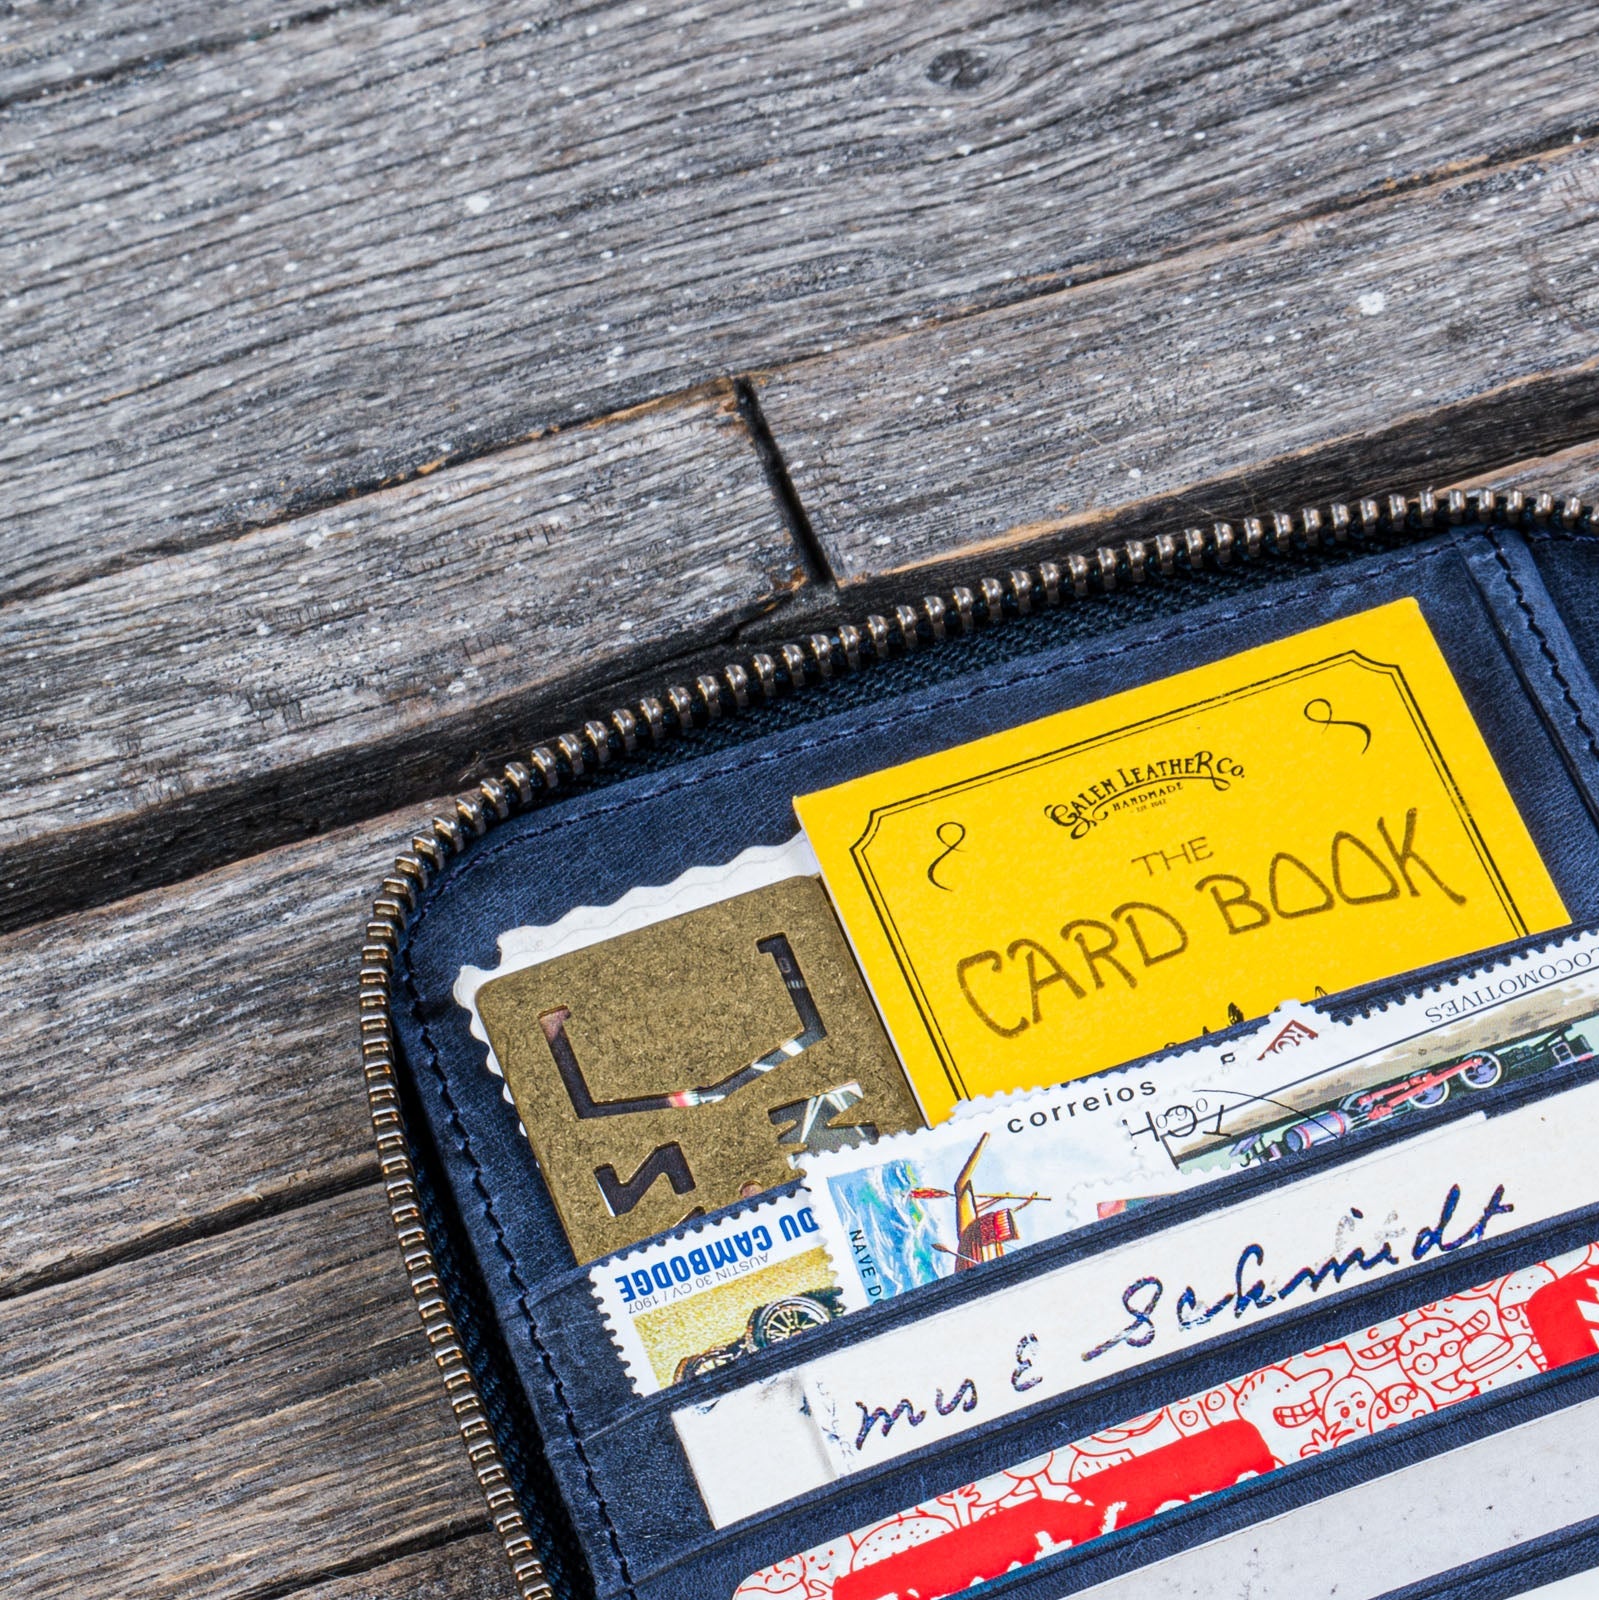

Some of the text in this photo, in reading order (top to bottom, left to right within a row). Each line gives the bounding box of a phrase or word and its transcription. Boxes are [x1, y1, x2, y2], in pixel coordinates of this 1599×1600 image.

[1117, 750, 1231, 791] LEATHER
[1112, 782, 1184, 812] HANDMADE
[1131, 836, 1214, 877] THE
[956, 806, 1467, 1038] CARD BOOK
[1006, 1080, 1158, 1135] correios
[615, 1206, 820, 1303] DU CAMBODGE
[715, 1253, 769, 1283] AUSTIN
[849, 1228, 876, 1279] NAVE
[671, 1278, 693, 1297] CV
[694, 1270, 713, 1289] 30
[627, 1294, 660, 1314] 1907
